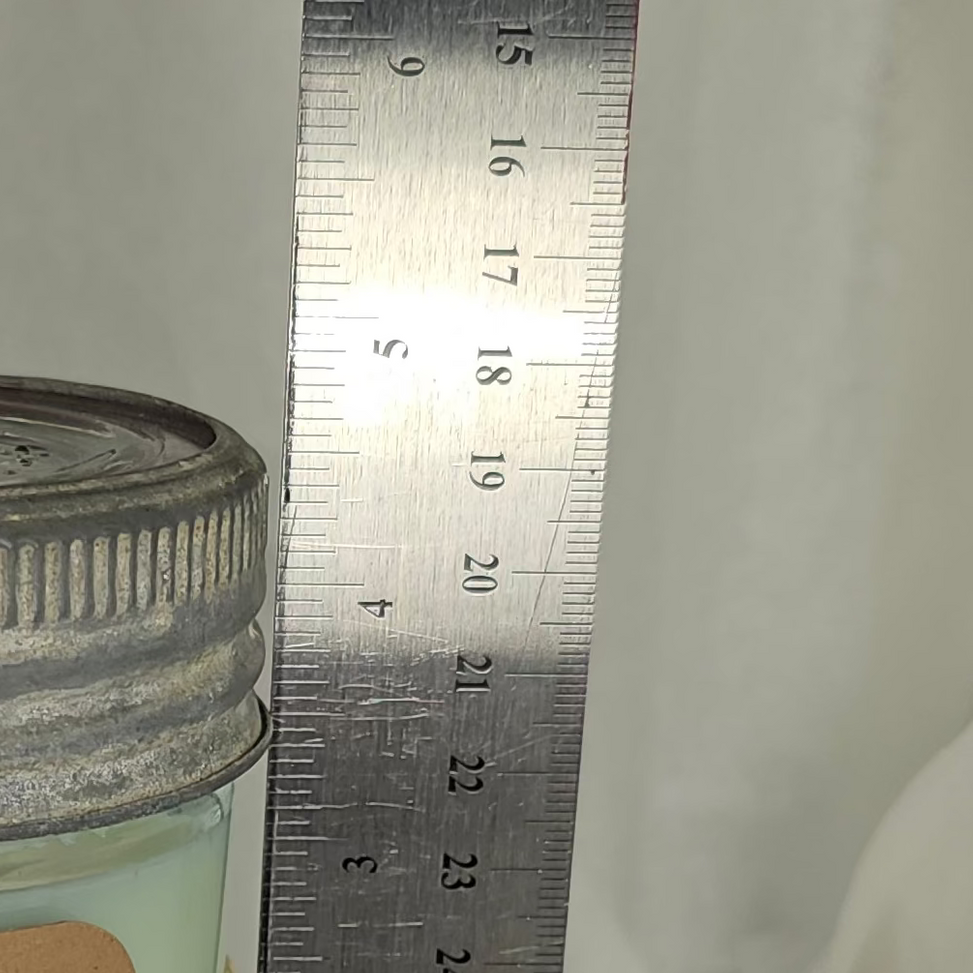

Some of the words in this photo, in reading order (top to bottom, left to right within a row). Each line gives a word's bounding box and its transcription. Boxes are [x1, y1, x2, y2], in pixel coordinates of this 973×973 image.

[495, 22, 535, 66] 15
[488, 135, 527, 178] 16
[481, 243, 520, 287] 17
[373, 338, 409, 361] 5
[475, 345, 513, 386] 18
[469, 450, 506, 491] 19
[462, 553, 500, 594] 20
[357, 599, 393, 619] 4
[455, 654, 493, 694] 21
[448, 754, 486, 795] 22
[341, 855, 379, 875] 3
[440, 852, 478, 891] 23
